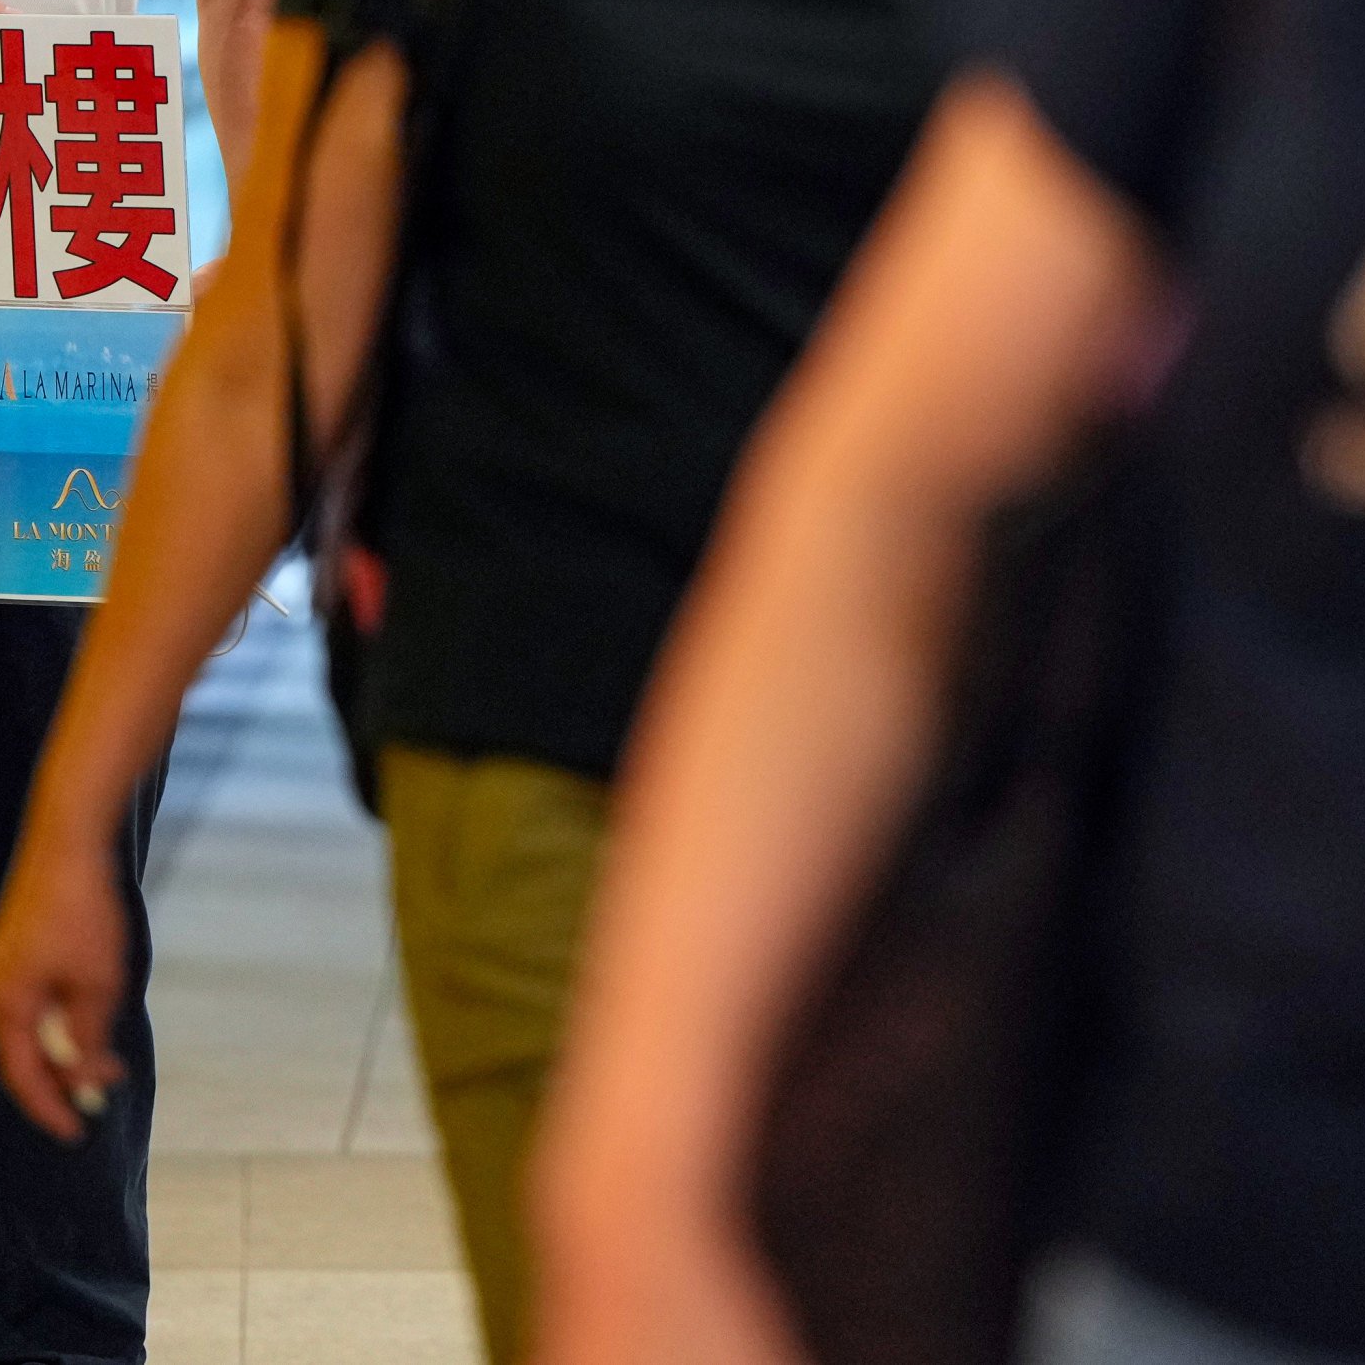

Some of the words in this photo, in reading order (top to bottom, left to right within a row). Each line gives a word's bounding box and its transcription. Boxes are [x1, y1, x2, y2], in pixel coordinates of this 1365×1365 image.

[23, 370, 47, 400] LA
[55, 371, 137, 402] MARINA
[13, 521, 42, 541] LA
